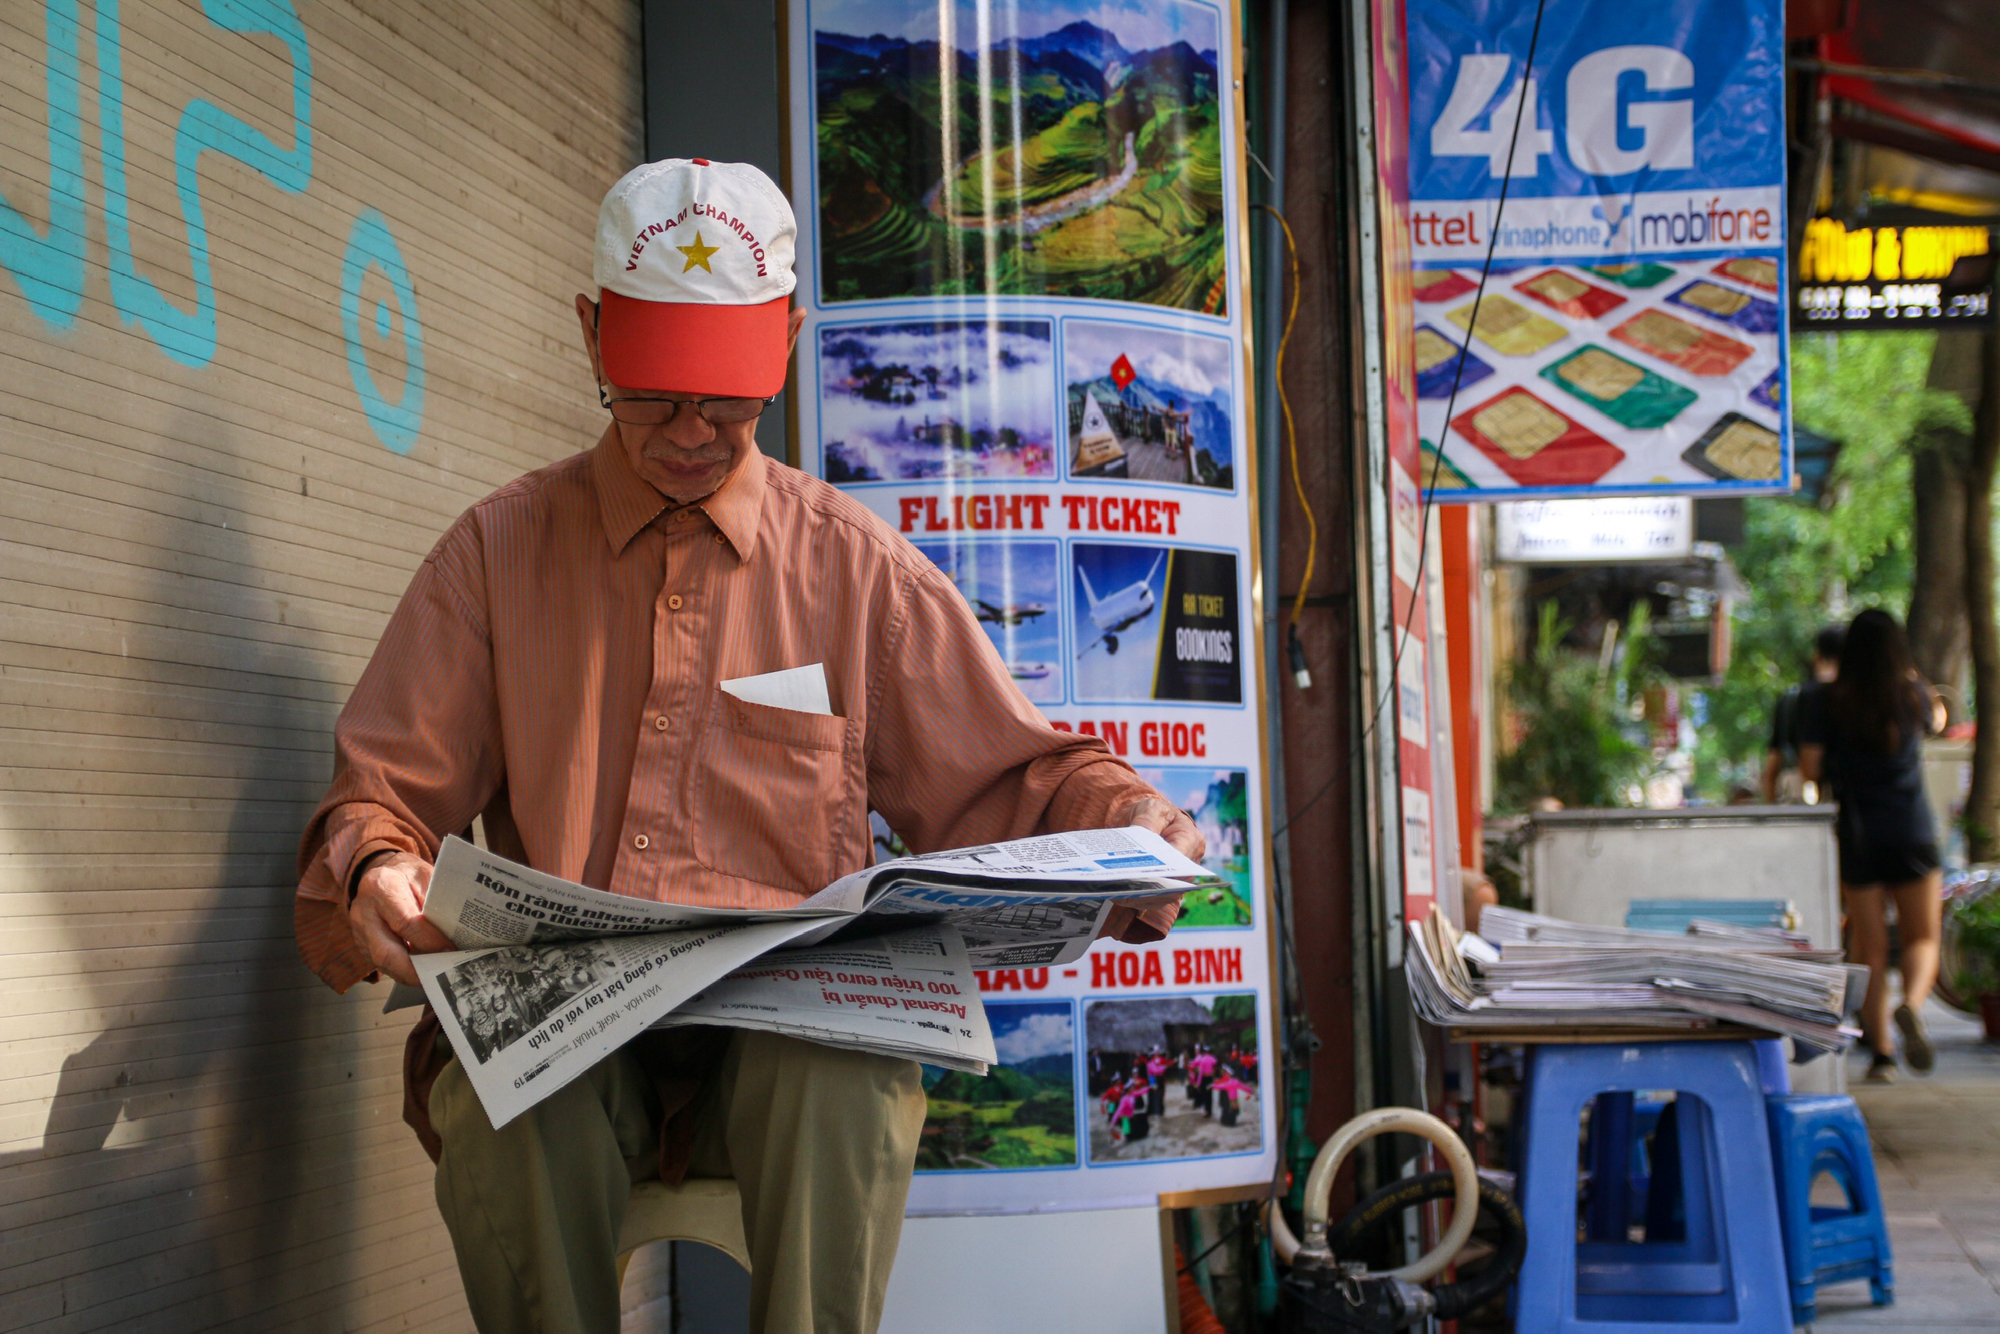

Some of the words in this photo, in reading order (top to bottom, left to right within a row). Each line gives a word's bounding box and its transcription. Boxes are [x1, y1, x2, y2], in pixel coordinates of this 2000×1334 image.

[1430, 44, 1695, 178] 4G
[1412, 211, 1481, 246] ttel
[1641, 197, 1771, 246] mobifone
[625, 207, 688, 271] VIETNAM
[692, 203, 767, 277] CHAMPION
[899, 495, 1050, 533] FLIGHT
[1061, 496, 1181, 535] TICKET
[1198, 595, 1224, 618] TICKET
[1176, 627, 1233, 664] BOOKINGS
[1140, 722, 1206, 758] GIOC
[475, 872, 519, 899] Rộn
[505, 901, 546, 920] cho
[670, 934, 705, 957] thống
[654, 953, 669, 969] cố
[1090, 950, 1164, 988] HOA
[1173, 948, 1242, 985] BINH
[623, 960, 653, 984] gắng
[801, 968, 834, 983] tậu
[837, 973, 877, 986] euro
[606, 979, 625, 998] bắt
[884, 975, 926, 993] triệu
[929, 980, 961, 995] 100
[584, 993, 604, 1010] tay
[822, 988, 841, 1004] bị
[845, 994, 898, 1011] chuẩn
[565, 1006, 584, 1025] với
[903, 998, 966, 1019] Arsenal
[550, 1016, 565, 1035] du
[596, 1010, 621, 1033] NGHỆ
[528, 1029, 551, 1049] lịch
[960, 1028, 973, 1039] 24
[514, 1077, 525, 1089] 19
